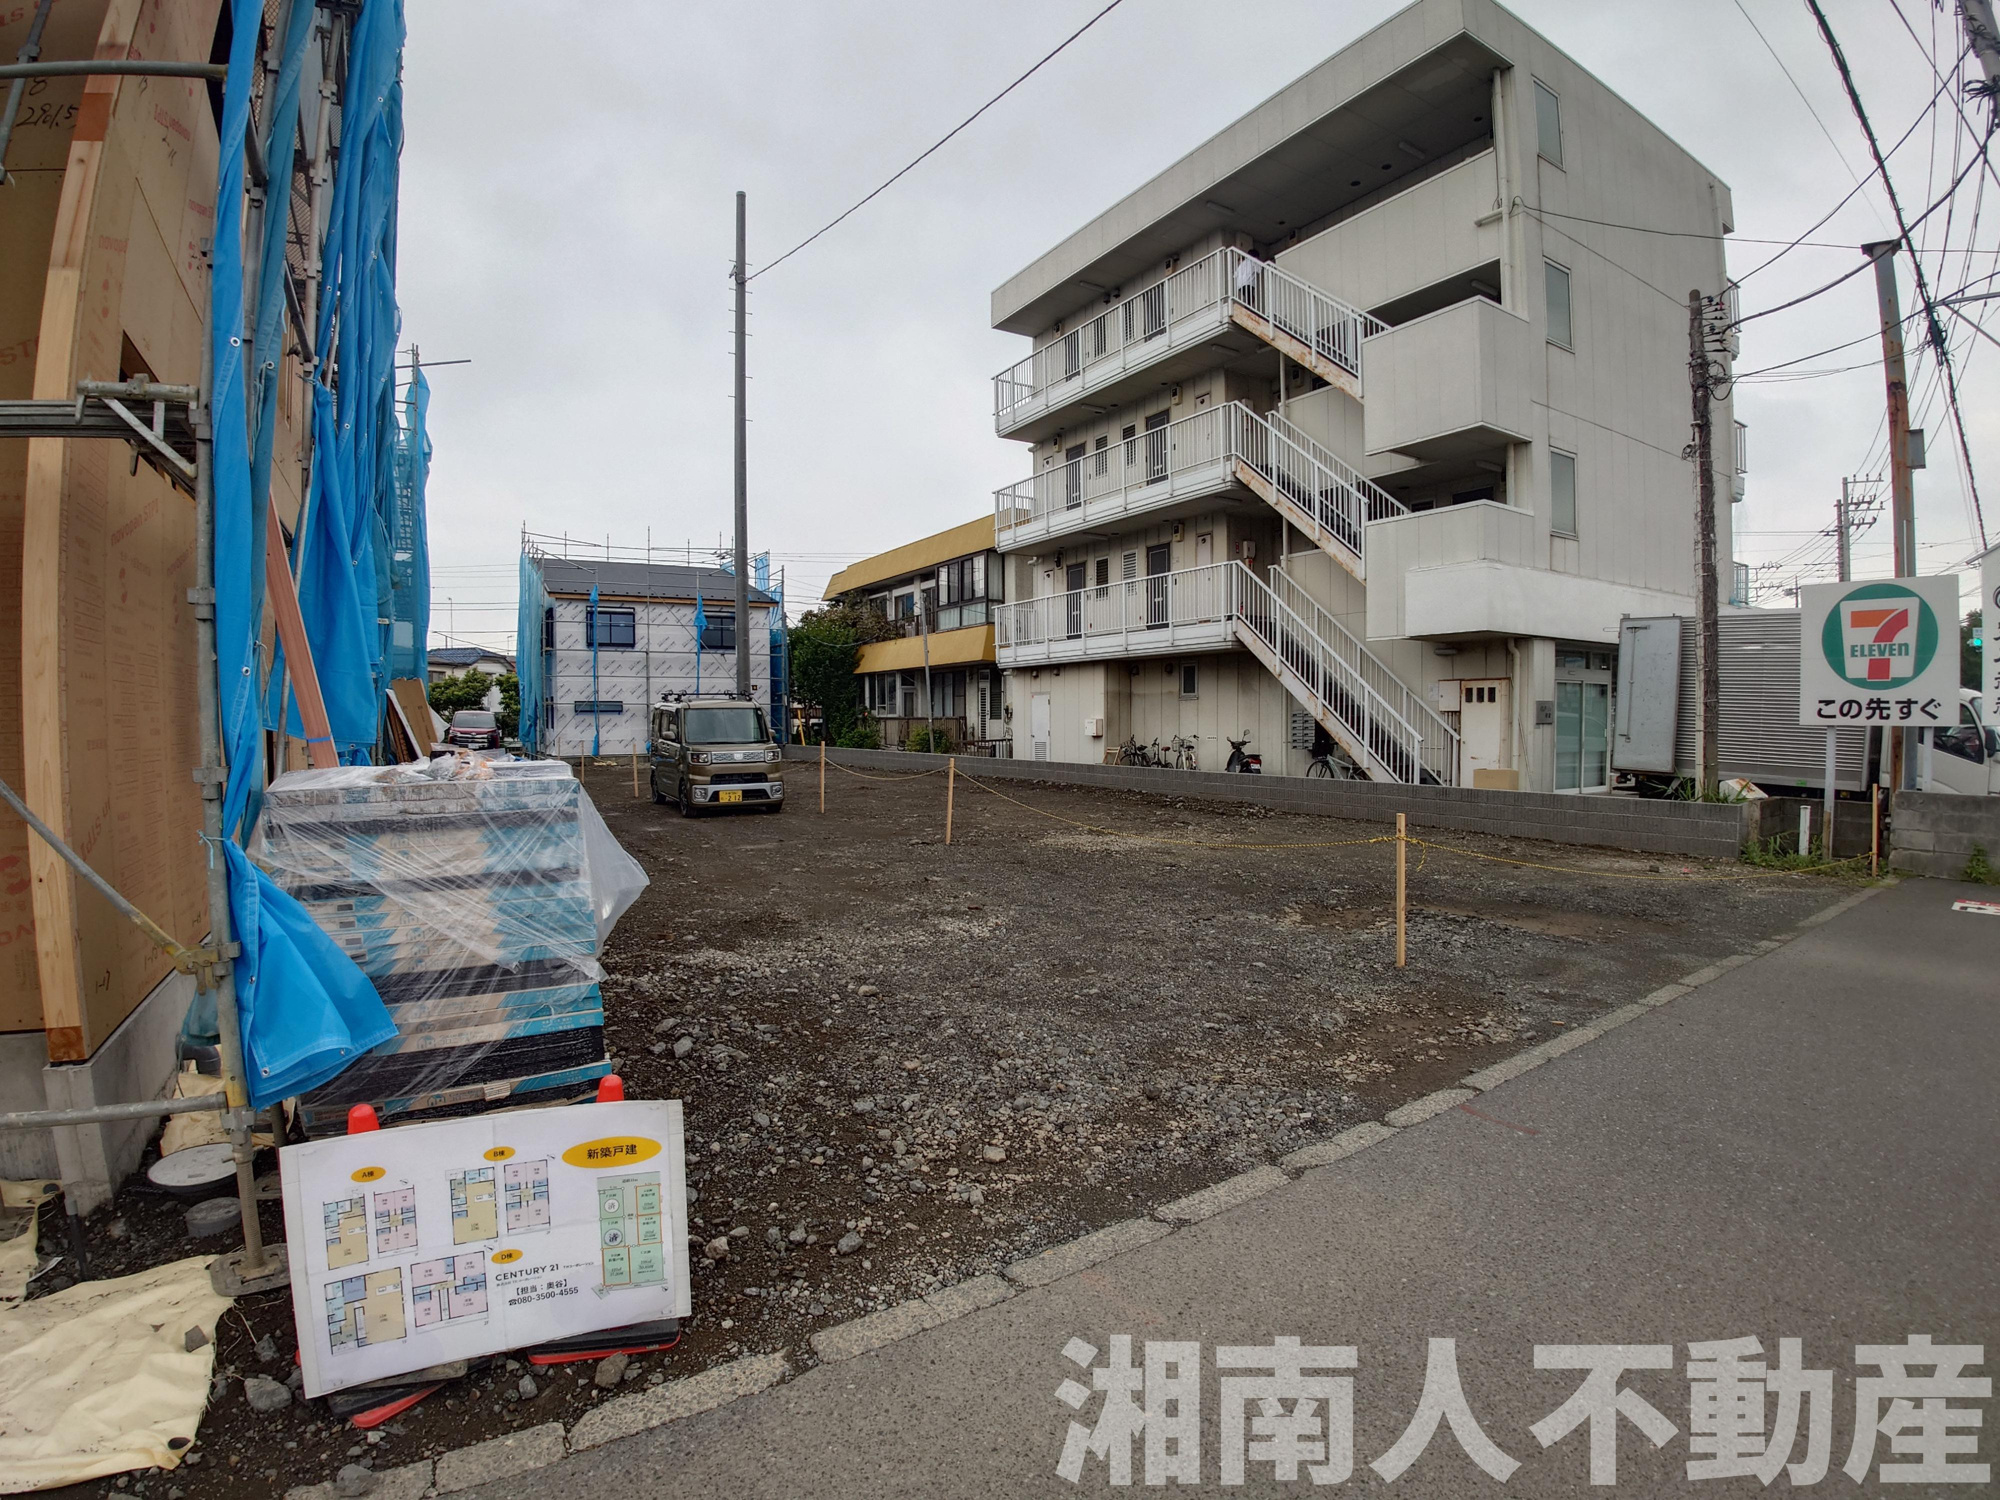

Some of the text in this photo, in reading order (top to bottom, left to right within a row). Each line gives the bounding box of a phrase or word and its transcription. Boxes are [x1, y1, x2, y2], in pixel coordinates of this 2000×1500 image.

[1850, 608, 1909, 681] 7
[1817, 698, 1942, 721] この先すぐ
[587, 1144, 638, 1160] 新築戸建
[495, 1265, 547, 1282] CENTURY
[549, 1263, 559, 1272] 21
